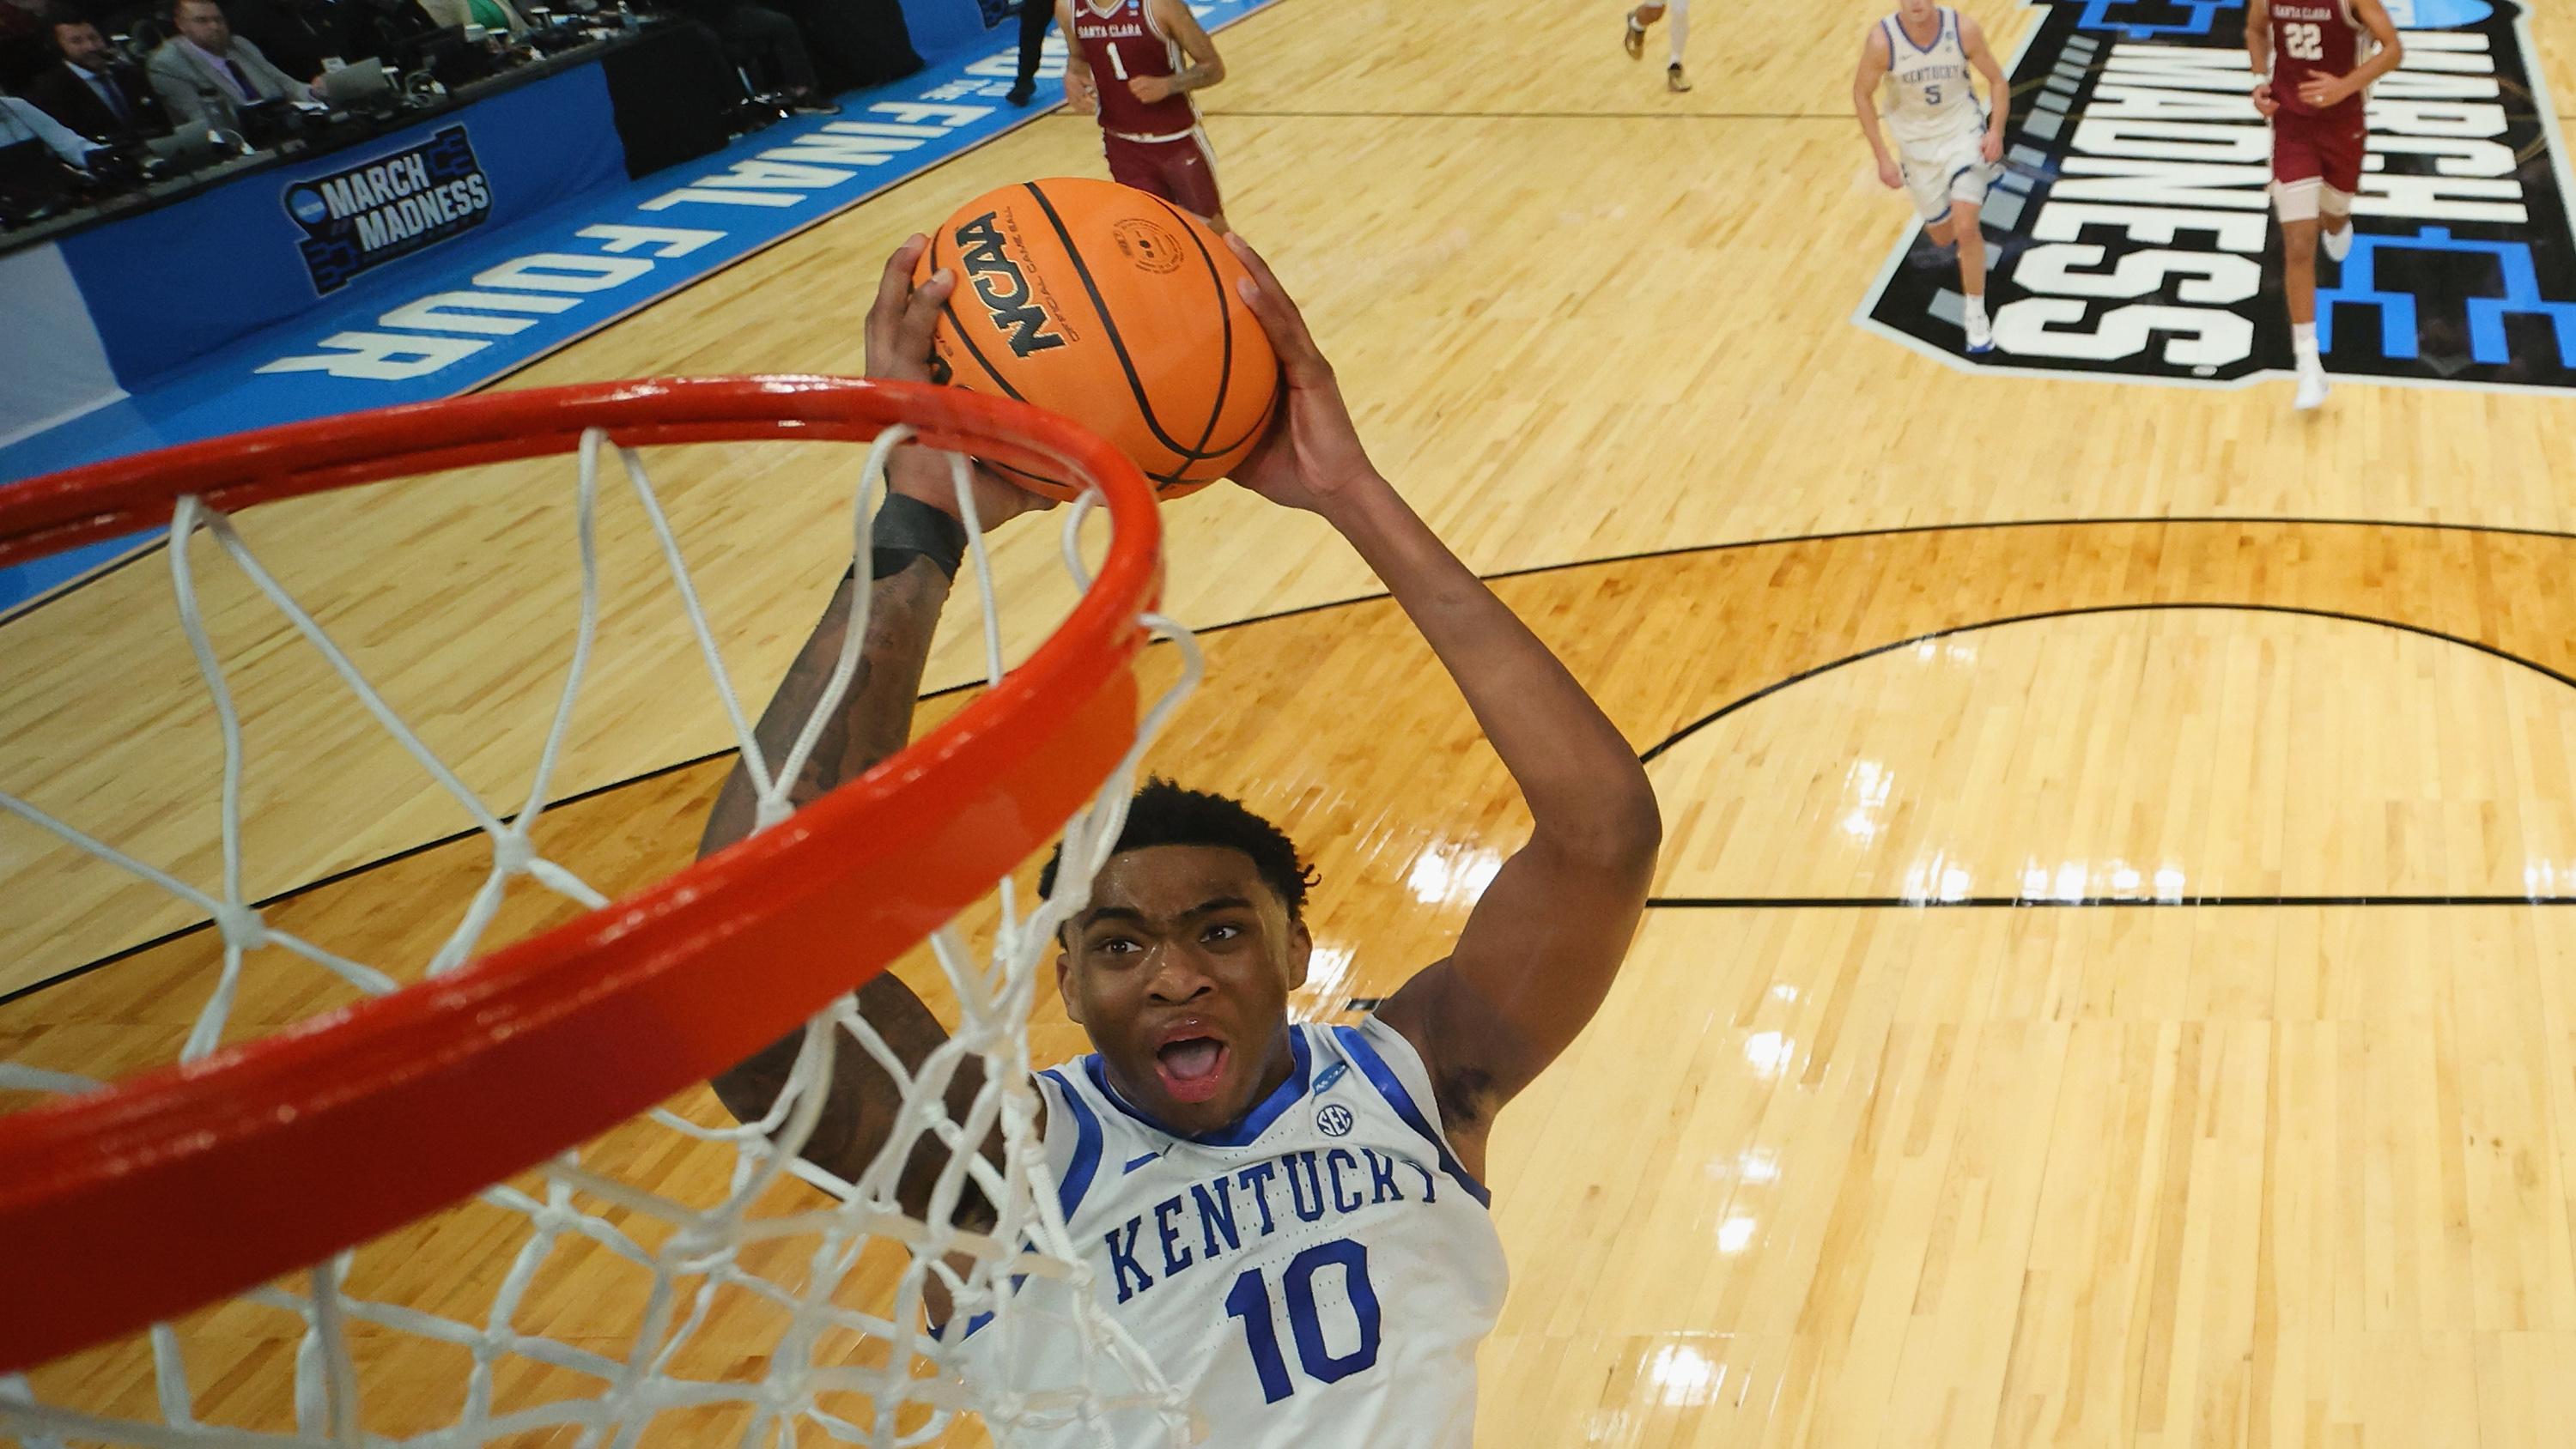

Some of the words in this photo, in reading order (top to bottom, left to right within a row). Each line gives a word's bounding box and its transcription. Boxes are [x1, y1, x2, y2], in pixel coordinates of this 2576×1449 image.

[1077, 25, 1108, 39] SANTA
[1109, 23, 1143, 38] CLARA
[1106, 41, 1129, 81] 1
[2284, 22, 2324, 61] 22
[1924, 85, 1941, 105] 5
[320, 153, 429, 221] MARCH
[638, 101, 996, 209] FINAL
[355, 173, 489, 252] MADNESS
[1992, 44, 2274, 367] MADNESS
[253, 224, 730, 381] FOUR
[955, 211, 1067, 359] NCAA
[1037, 275, 1080, 343] OFFICIAL
[1318, 1106, 1352, 1137] SEC
[1224, 1238, 1382, 1404] 10
